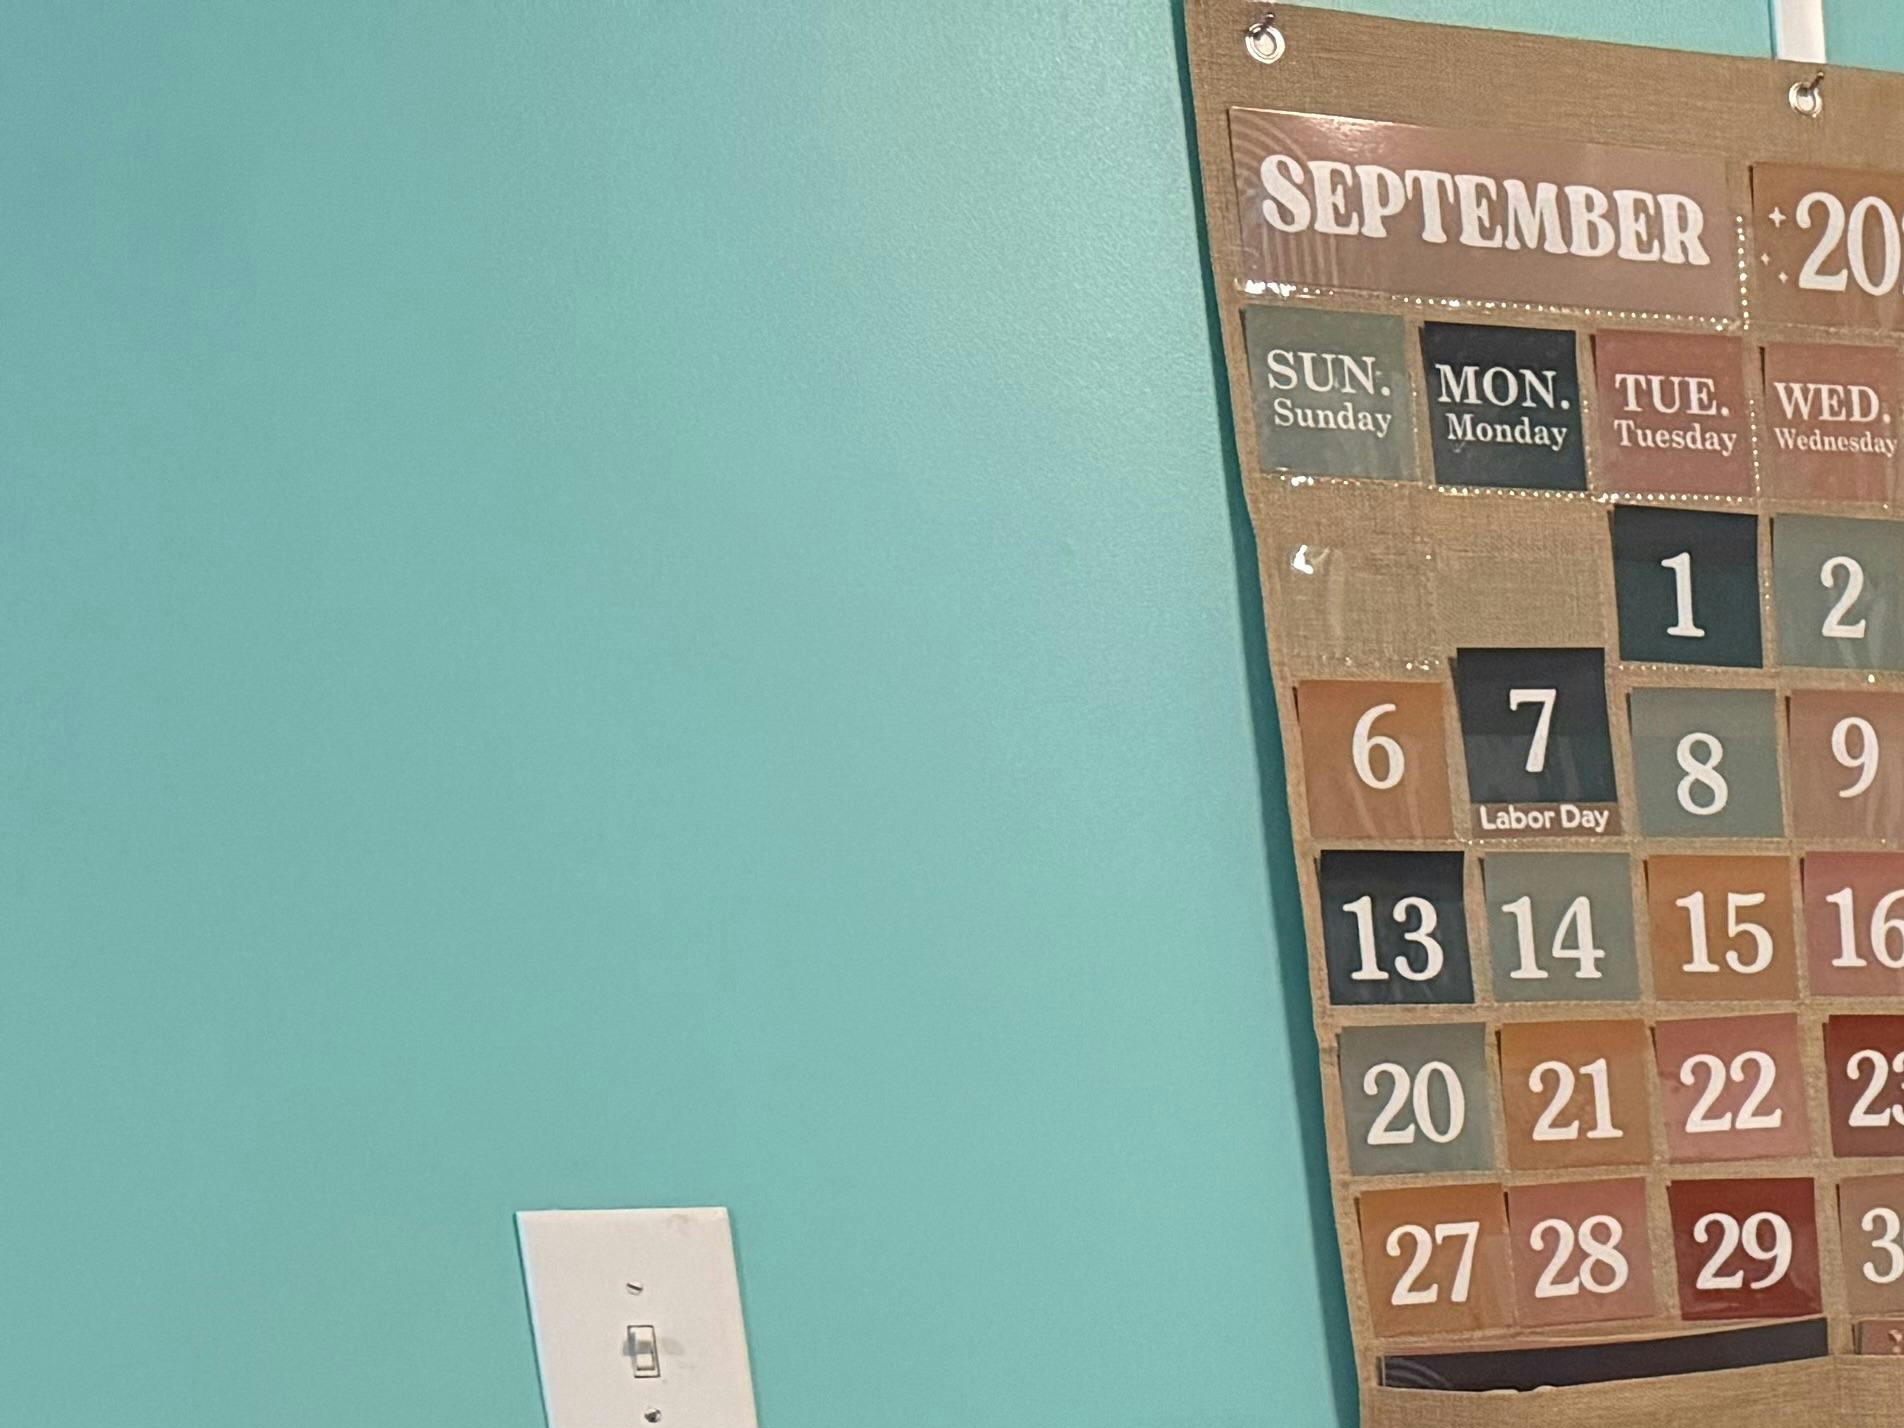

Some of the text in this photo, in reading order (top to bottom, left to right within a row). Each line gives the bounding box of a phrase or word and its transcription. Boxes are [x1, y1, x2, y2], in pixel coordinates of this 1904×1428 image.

[1260, 154, 1711, 266] SEPTEMBER
[1267, 349, 1391, 397] SUN.
[1435, 363, 1570, 410] MON.
[1614, 373, 1730, 417] TUE.
[1273, 397, 1392, 438] Sunday
[1773, 381, 1891, 424] WED.
[1445, 412, 1568, 452] Monday
[1613, 419, 1737, 457] Tuesday
[1773, 427, 1895, 459] Wednesday
[1661, 552, 1705, 638] 1
[1820, 556, 1866, 639] 2
[1352, 703, 1405, 790] 6
[1509, 688, 1557, 773] 7
[1676, 732, 1729, 816] 8
[1831, 716, 1879, 798] 9
[1479, 803, 1610, 834] Labor Day
[1342, 895, 1444, 981] 13
[1501, 895, 1606, 979] 14
[1675, 890, 1773, 974] 15
[1363, 1060, 1465, 1145] 20
[1528, 1057, 1624, 1141] 21
[1679, 1050, 1783, 1133] 22
[1386, 1221, 1480, 1306] 27
[1529, 1214, 1629, 1299] 28
[1693, 1211, 1793, 1290] 29
